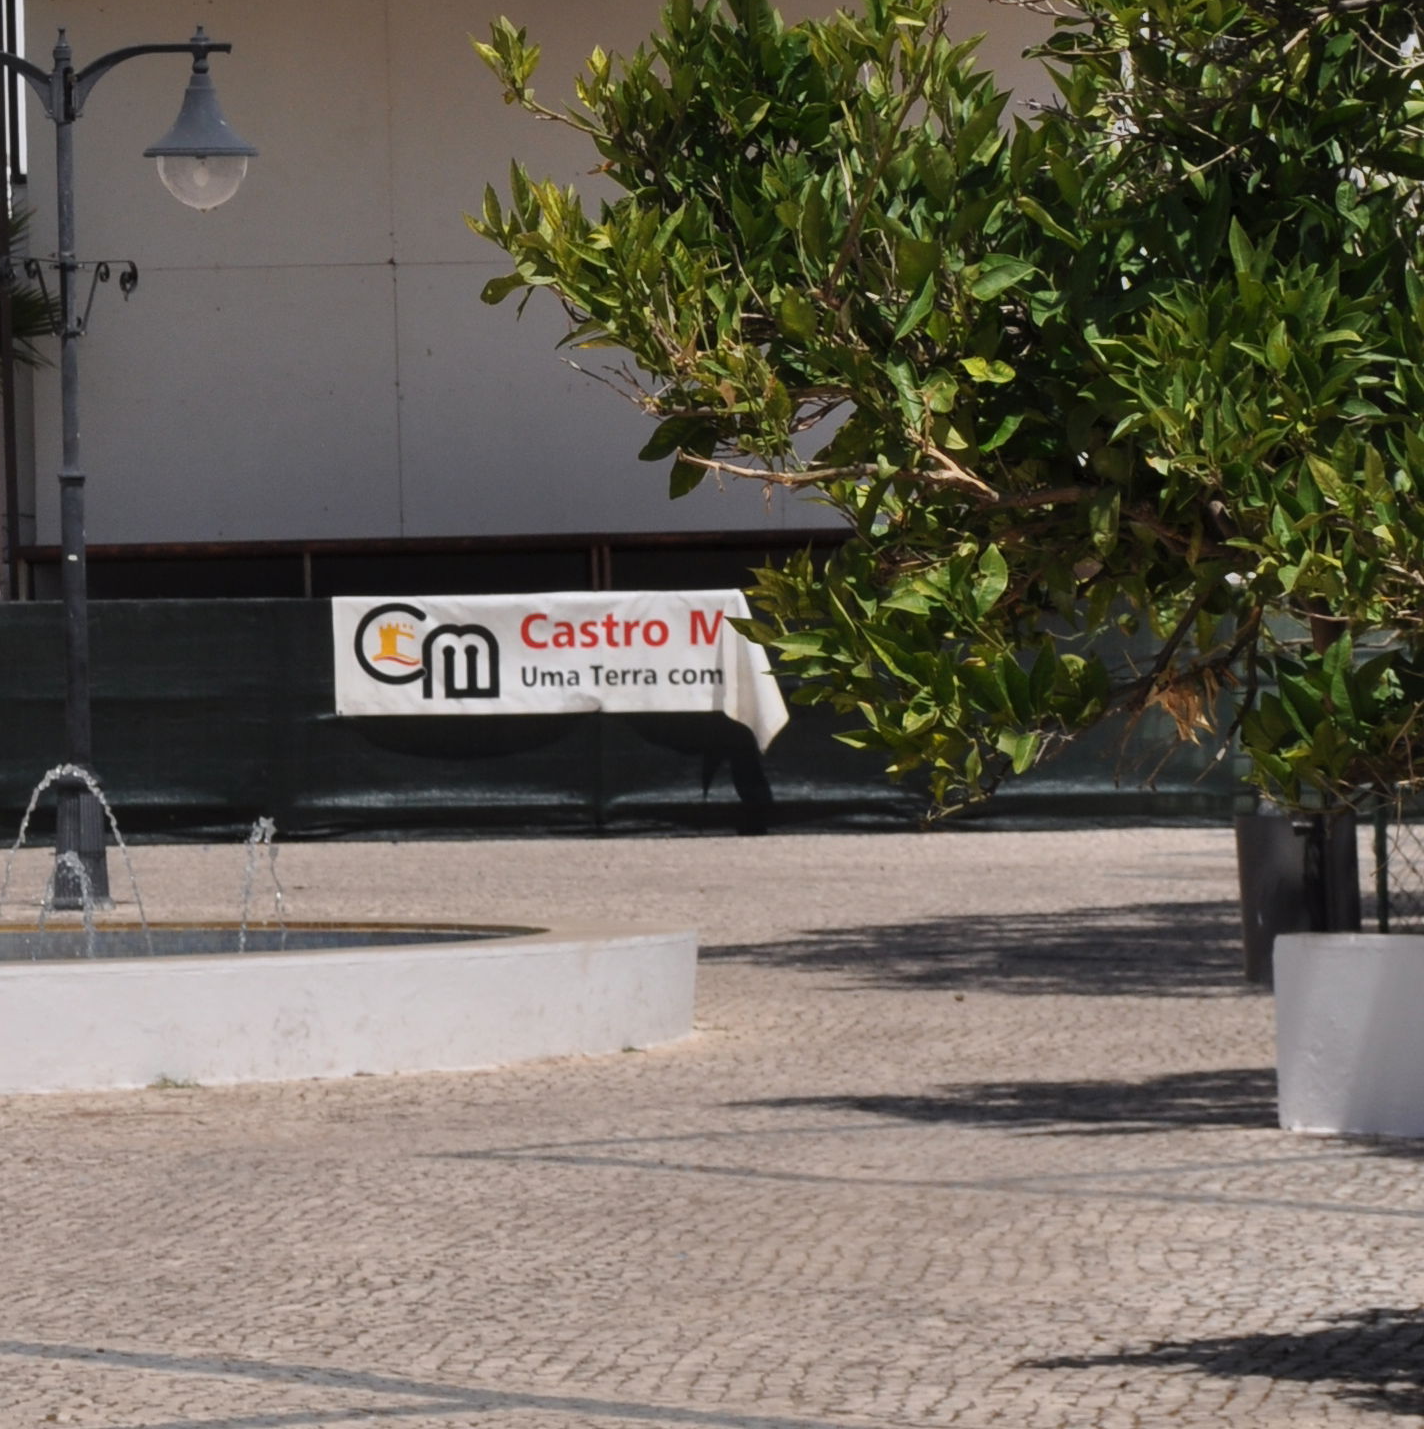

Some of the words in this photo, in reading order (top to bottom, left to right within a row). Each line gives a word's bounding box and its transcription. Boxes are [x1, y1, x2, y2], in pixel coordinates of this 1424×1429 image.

[520, 613, 669, 649] Castro
[521, 665, 580, 687] Uma
[590, 664, 657, 686] Terra
[668, 668, 723, 685] com
